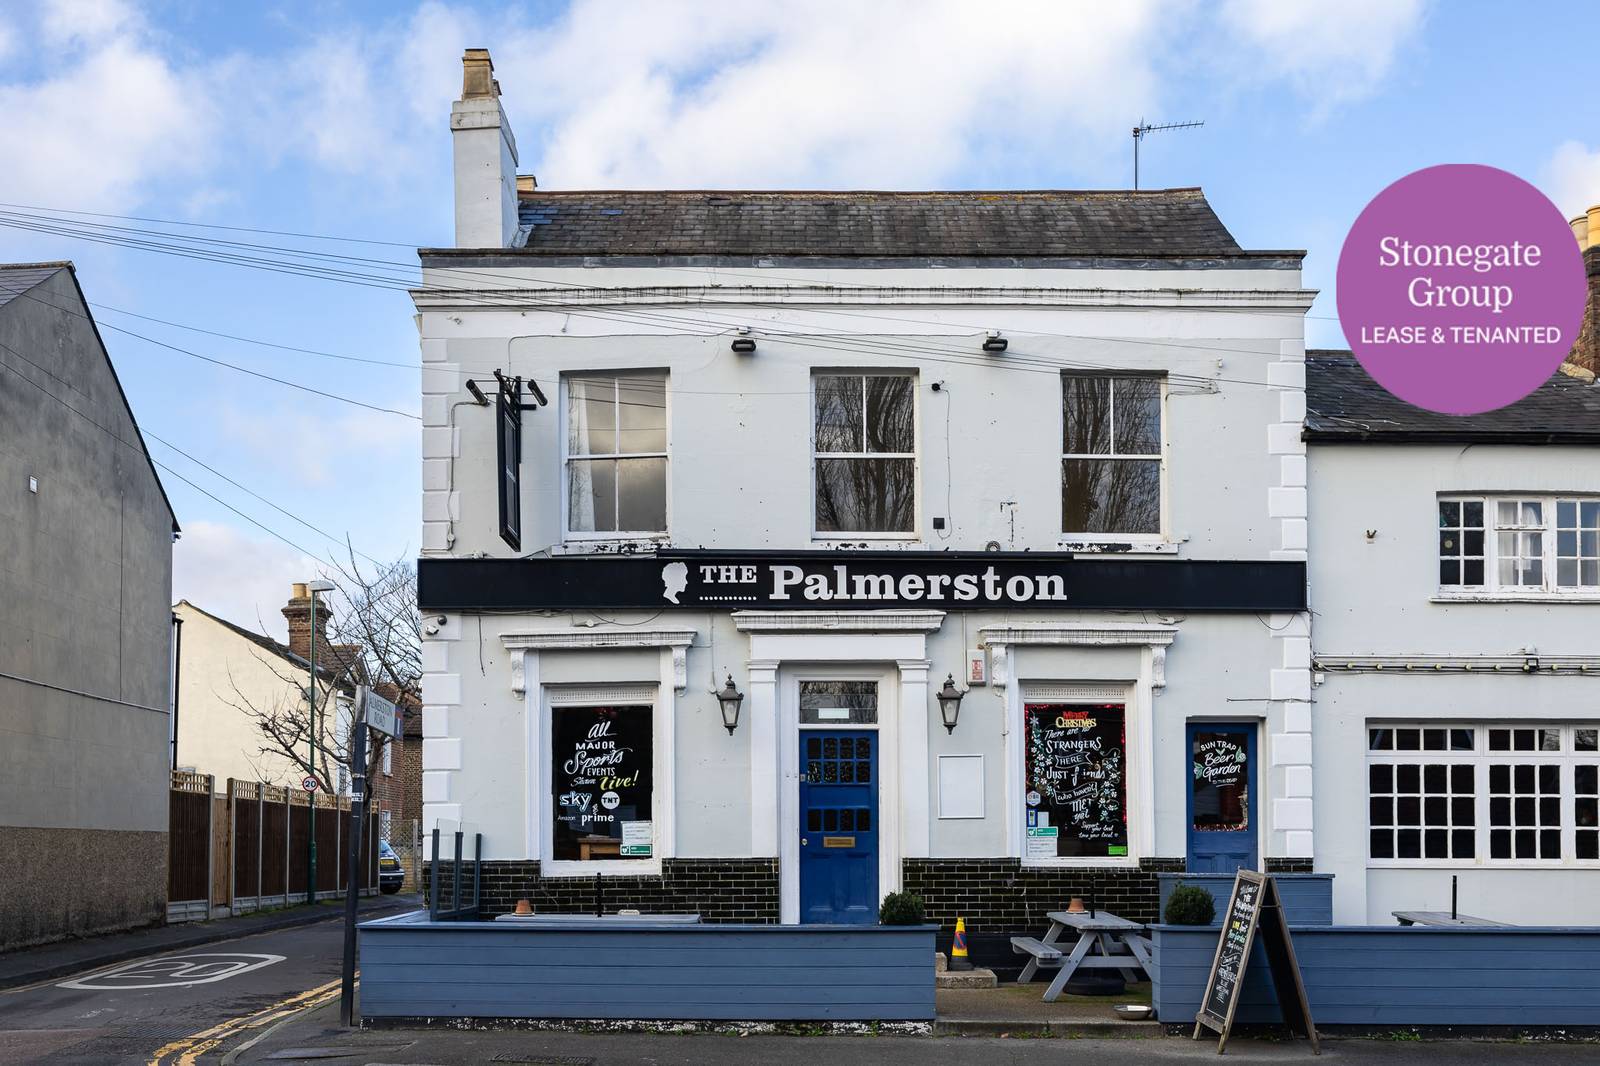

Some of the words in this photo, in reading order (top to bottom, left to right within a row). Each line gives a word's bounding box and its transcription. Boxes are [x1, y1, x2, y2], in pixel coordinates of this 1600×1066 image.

[699, 565, 757, 584] THE
[768, 565, 1067, 602] Palmerston
[1044, 729, 1065, 740] There
[1066, 728, 1079, 736] are
[575, 740, 616, 750] MAJOR
[1045, 736, 1102, 754] STRANGERS
[1200, 740, 1216, 752] SUN
[1216, 740, 1237, 751] TRAP
[564, 749, 626, 776] Sports
[1059, 754, 1082, 766] HERE
[1204, 752, 1235, 767] Beer
[586, 767, 615, 777] EVENTS
[1202, 762, 1241, 783] Garden
[305, 780, 316, 788] 20
[559, 790, 593, 812] sky
[1057, 791, 1073, 801] who
[581, 812, 614, 826] prime
[104, 961, 249, 979] 20
